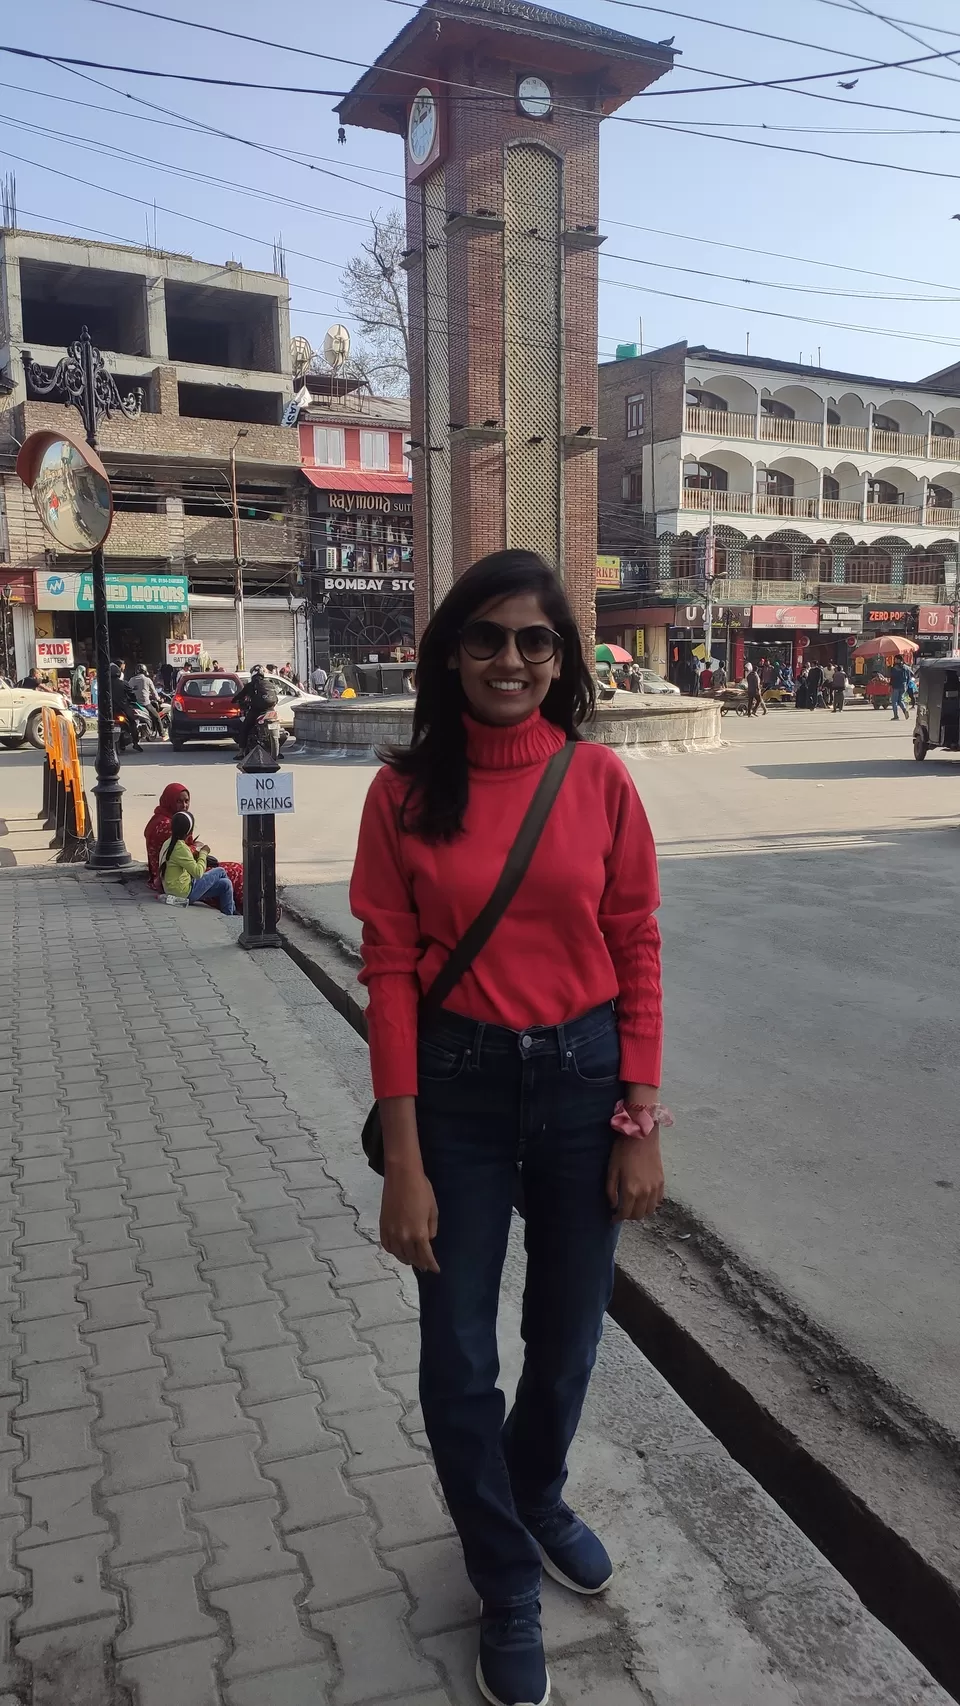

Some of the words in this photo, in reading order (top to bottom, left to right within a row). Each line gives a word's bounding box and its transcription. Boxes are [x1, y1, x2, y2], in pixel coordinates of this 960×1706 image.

[328, 493, 391, 513] Raymond
[324, 578, 384, 590] BOMBAY
[131, 585, 185, 603] MOTORS
[869, 611, 888, 621] ZERO
[38, 643, 70, 655] EXIDE
[168, 643, 201, 655] EXIDE
[43, 656, 68, 664] BATTERY
[255, 778, 275, 790] NO
[240, 796, 293, 810] PARKING
